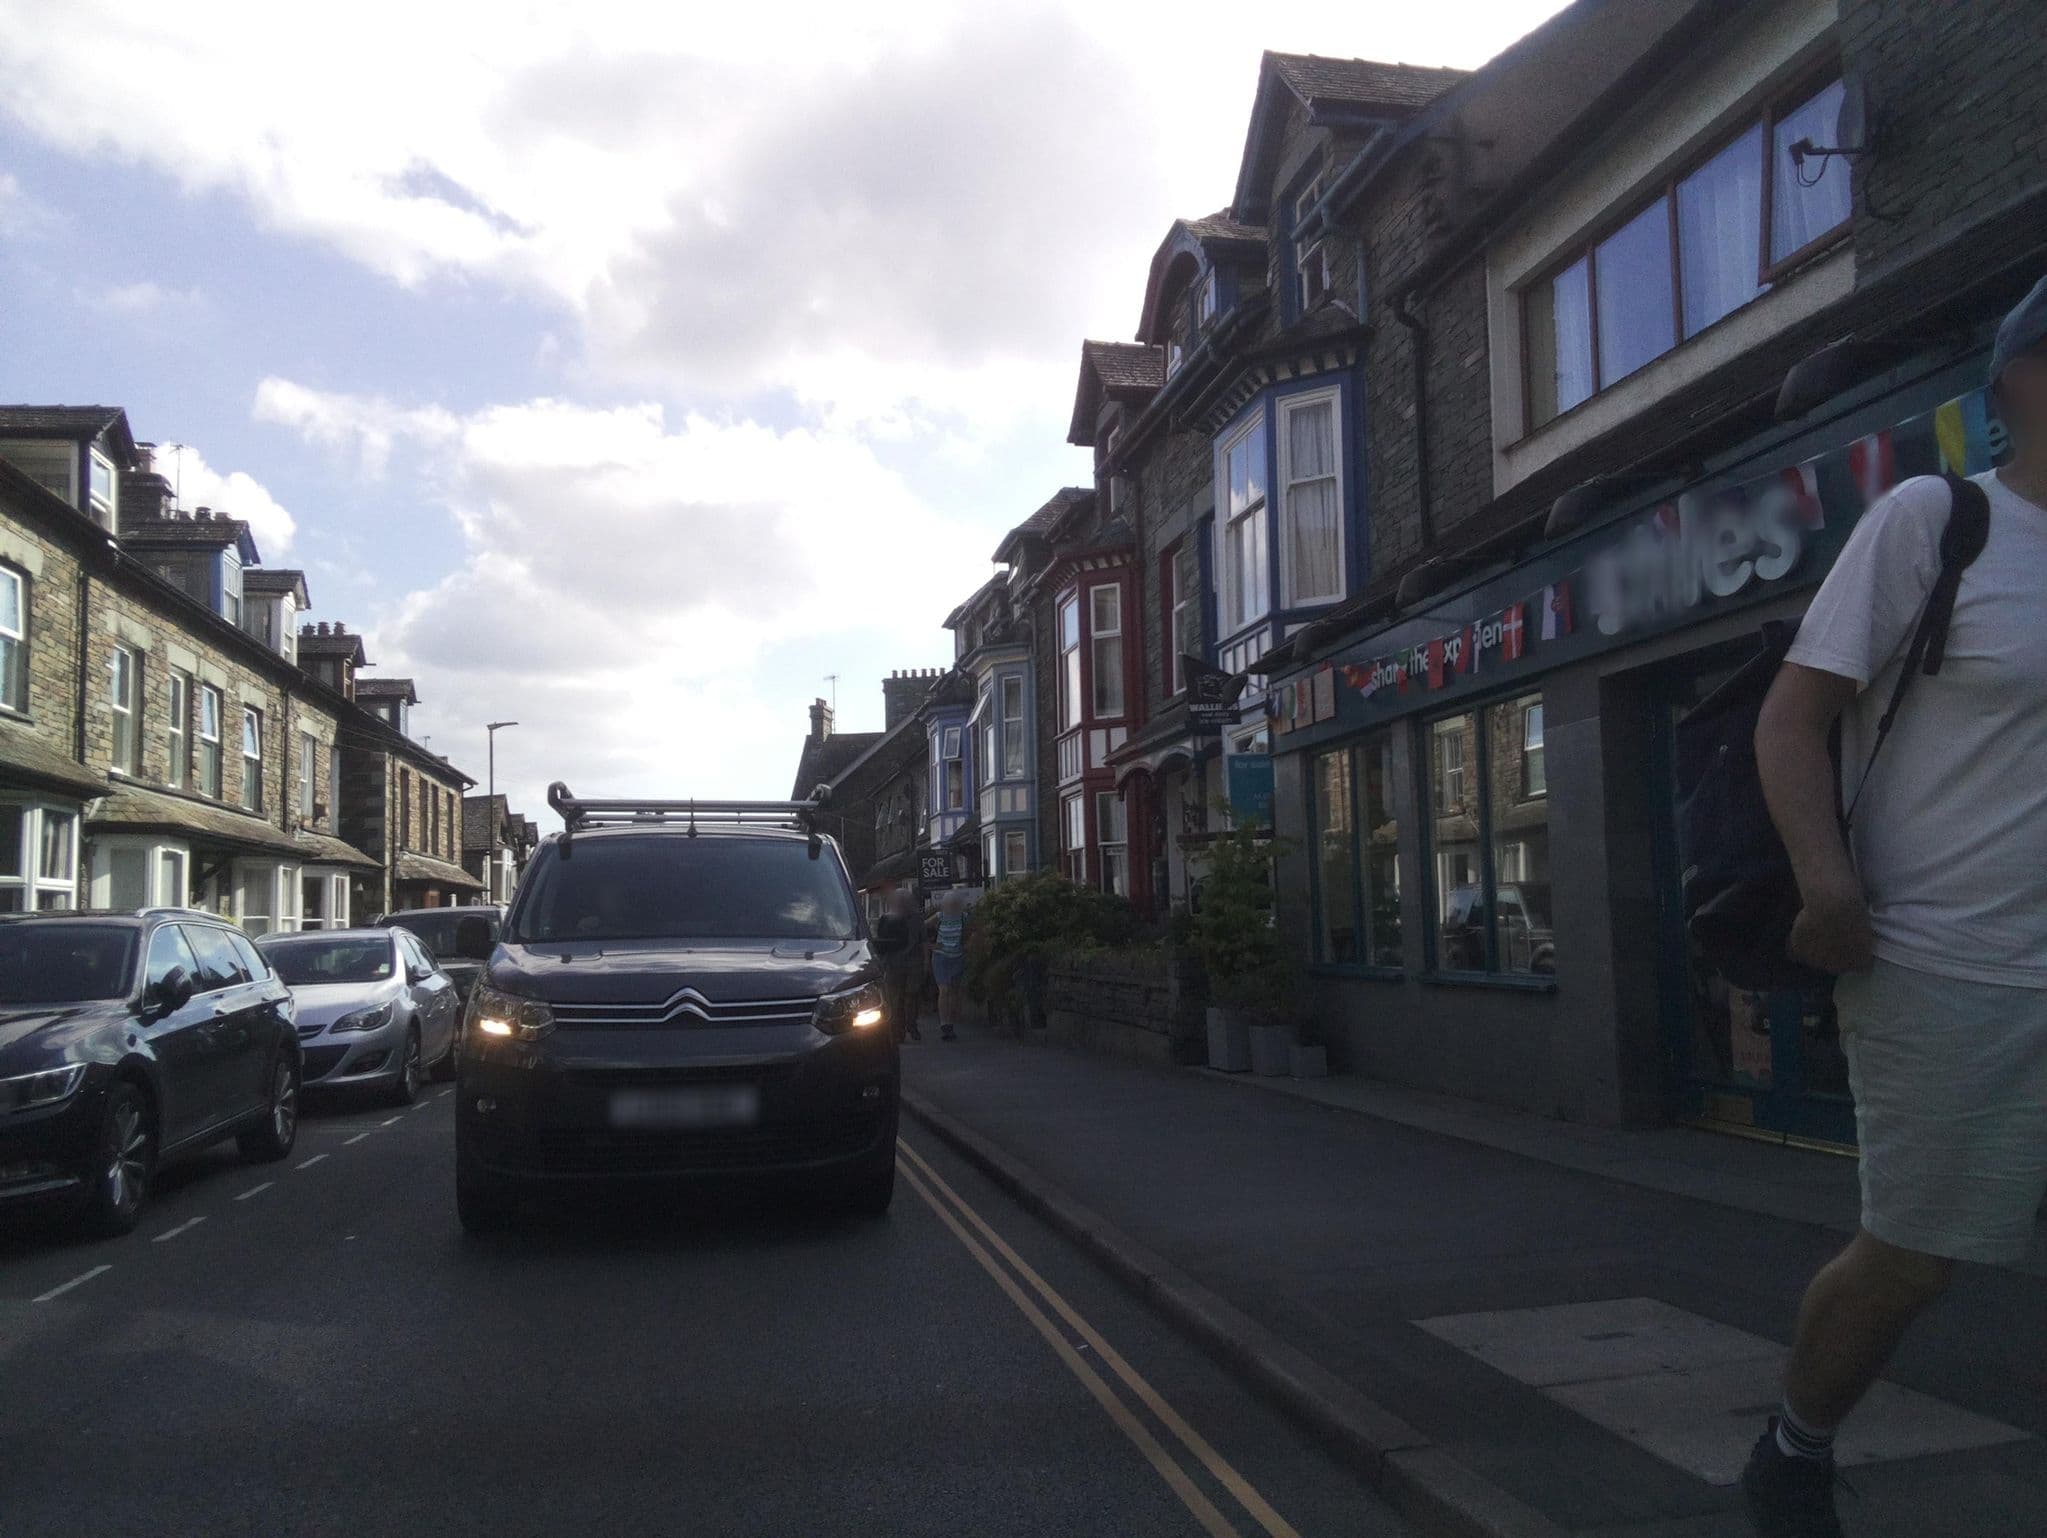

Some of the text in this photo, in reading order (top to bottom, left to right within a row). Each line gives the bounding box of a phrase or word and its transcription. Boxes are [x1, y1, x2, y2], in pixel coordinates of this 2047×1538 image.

[1371, 658, 1401, 691] shar
[921, 857, 945, 868] FOR
[922, 866, 950, 878] SALE
